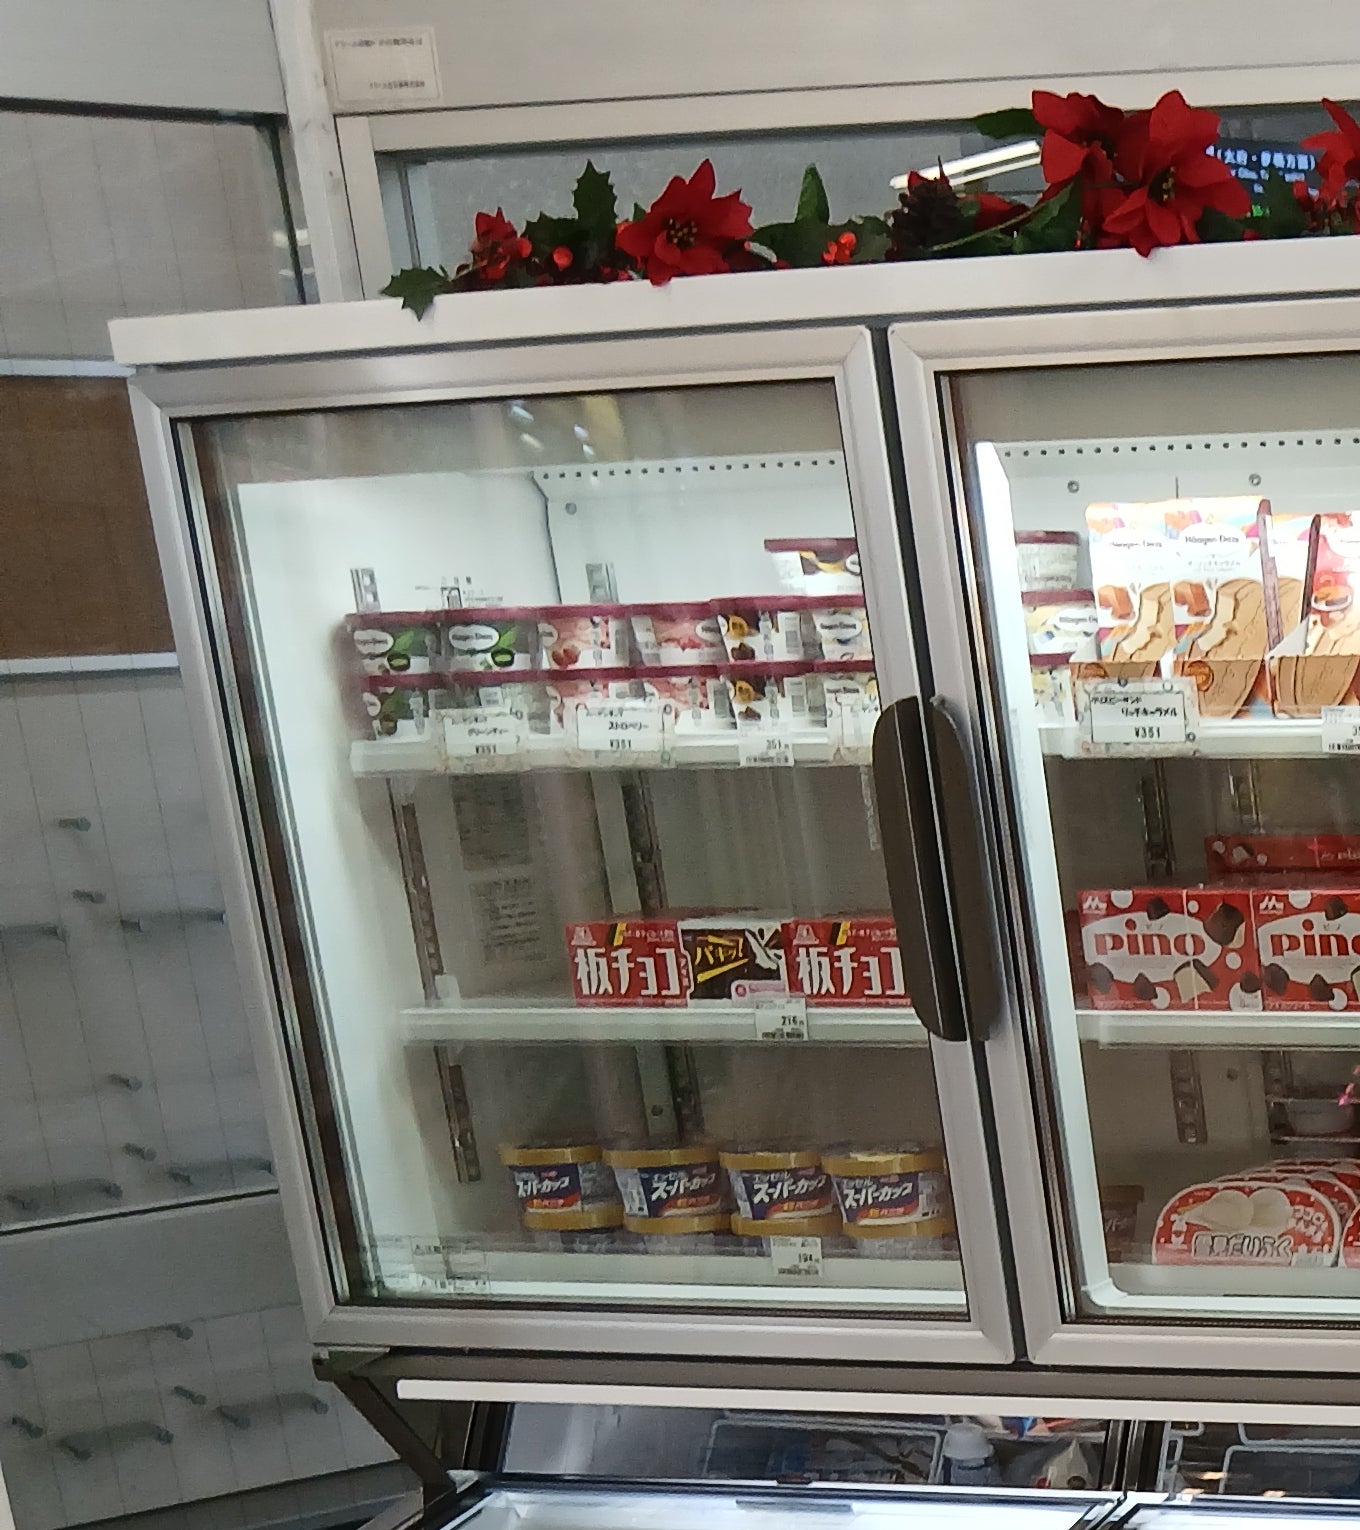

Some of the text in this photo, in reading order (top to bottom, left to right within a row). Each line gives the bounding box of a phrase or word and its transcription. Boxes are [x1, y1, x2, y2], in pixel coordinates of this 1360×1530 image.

[1094, 918, 1207, 957] pino
[574, 947, 681, 995] 板チョコ
[796, 946, 906, 996] 板チョコ
[516, 1175, 570, 1198] スーパーカップ
[650, 1173, 717, 1201] スーパーカップ
[753, 1175, 827, 1204] スーパーカップ
[843, 1182, 913, 1209] スーパーカップ
